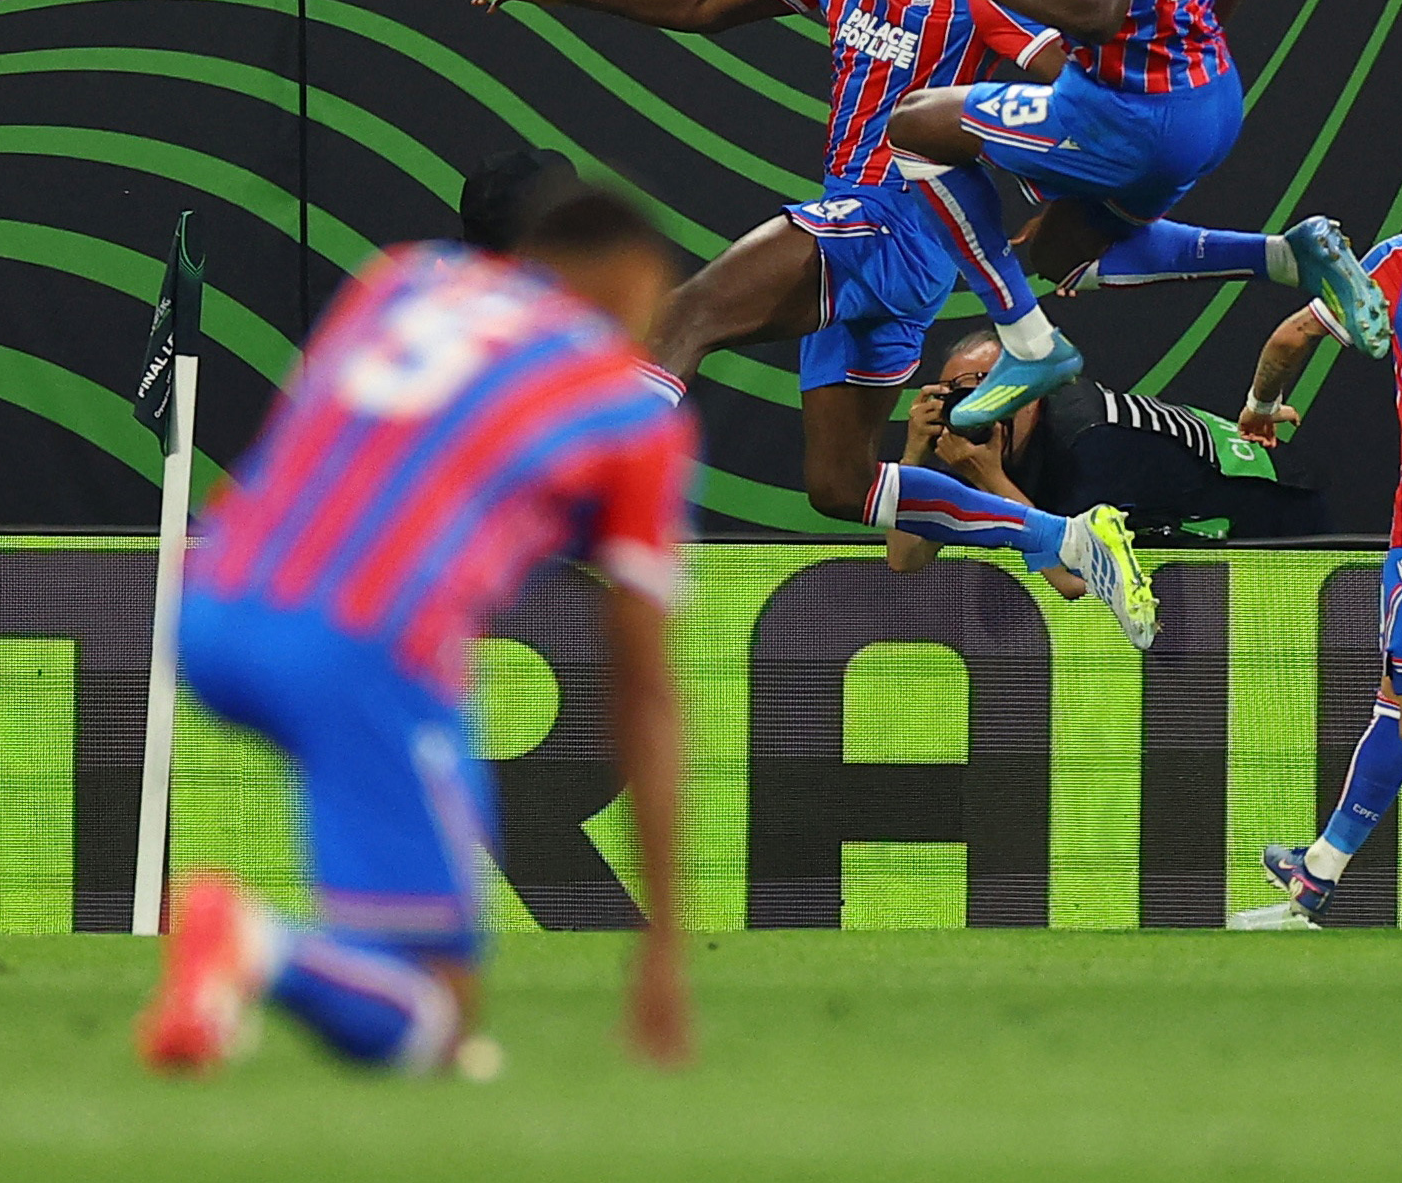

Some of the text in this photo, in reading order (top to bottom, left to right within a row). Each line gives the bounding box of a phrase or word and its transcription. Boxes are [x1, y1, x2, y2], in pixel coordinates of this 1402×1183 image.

[837, 22, 916, 70] FOR LIFE
[845, 7, 919, 52] PALACE
[137, 354, 170, 399] FINAL
[1351, 802, 1380, 823] CPFC
